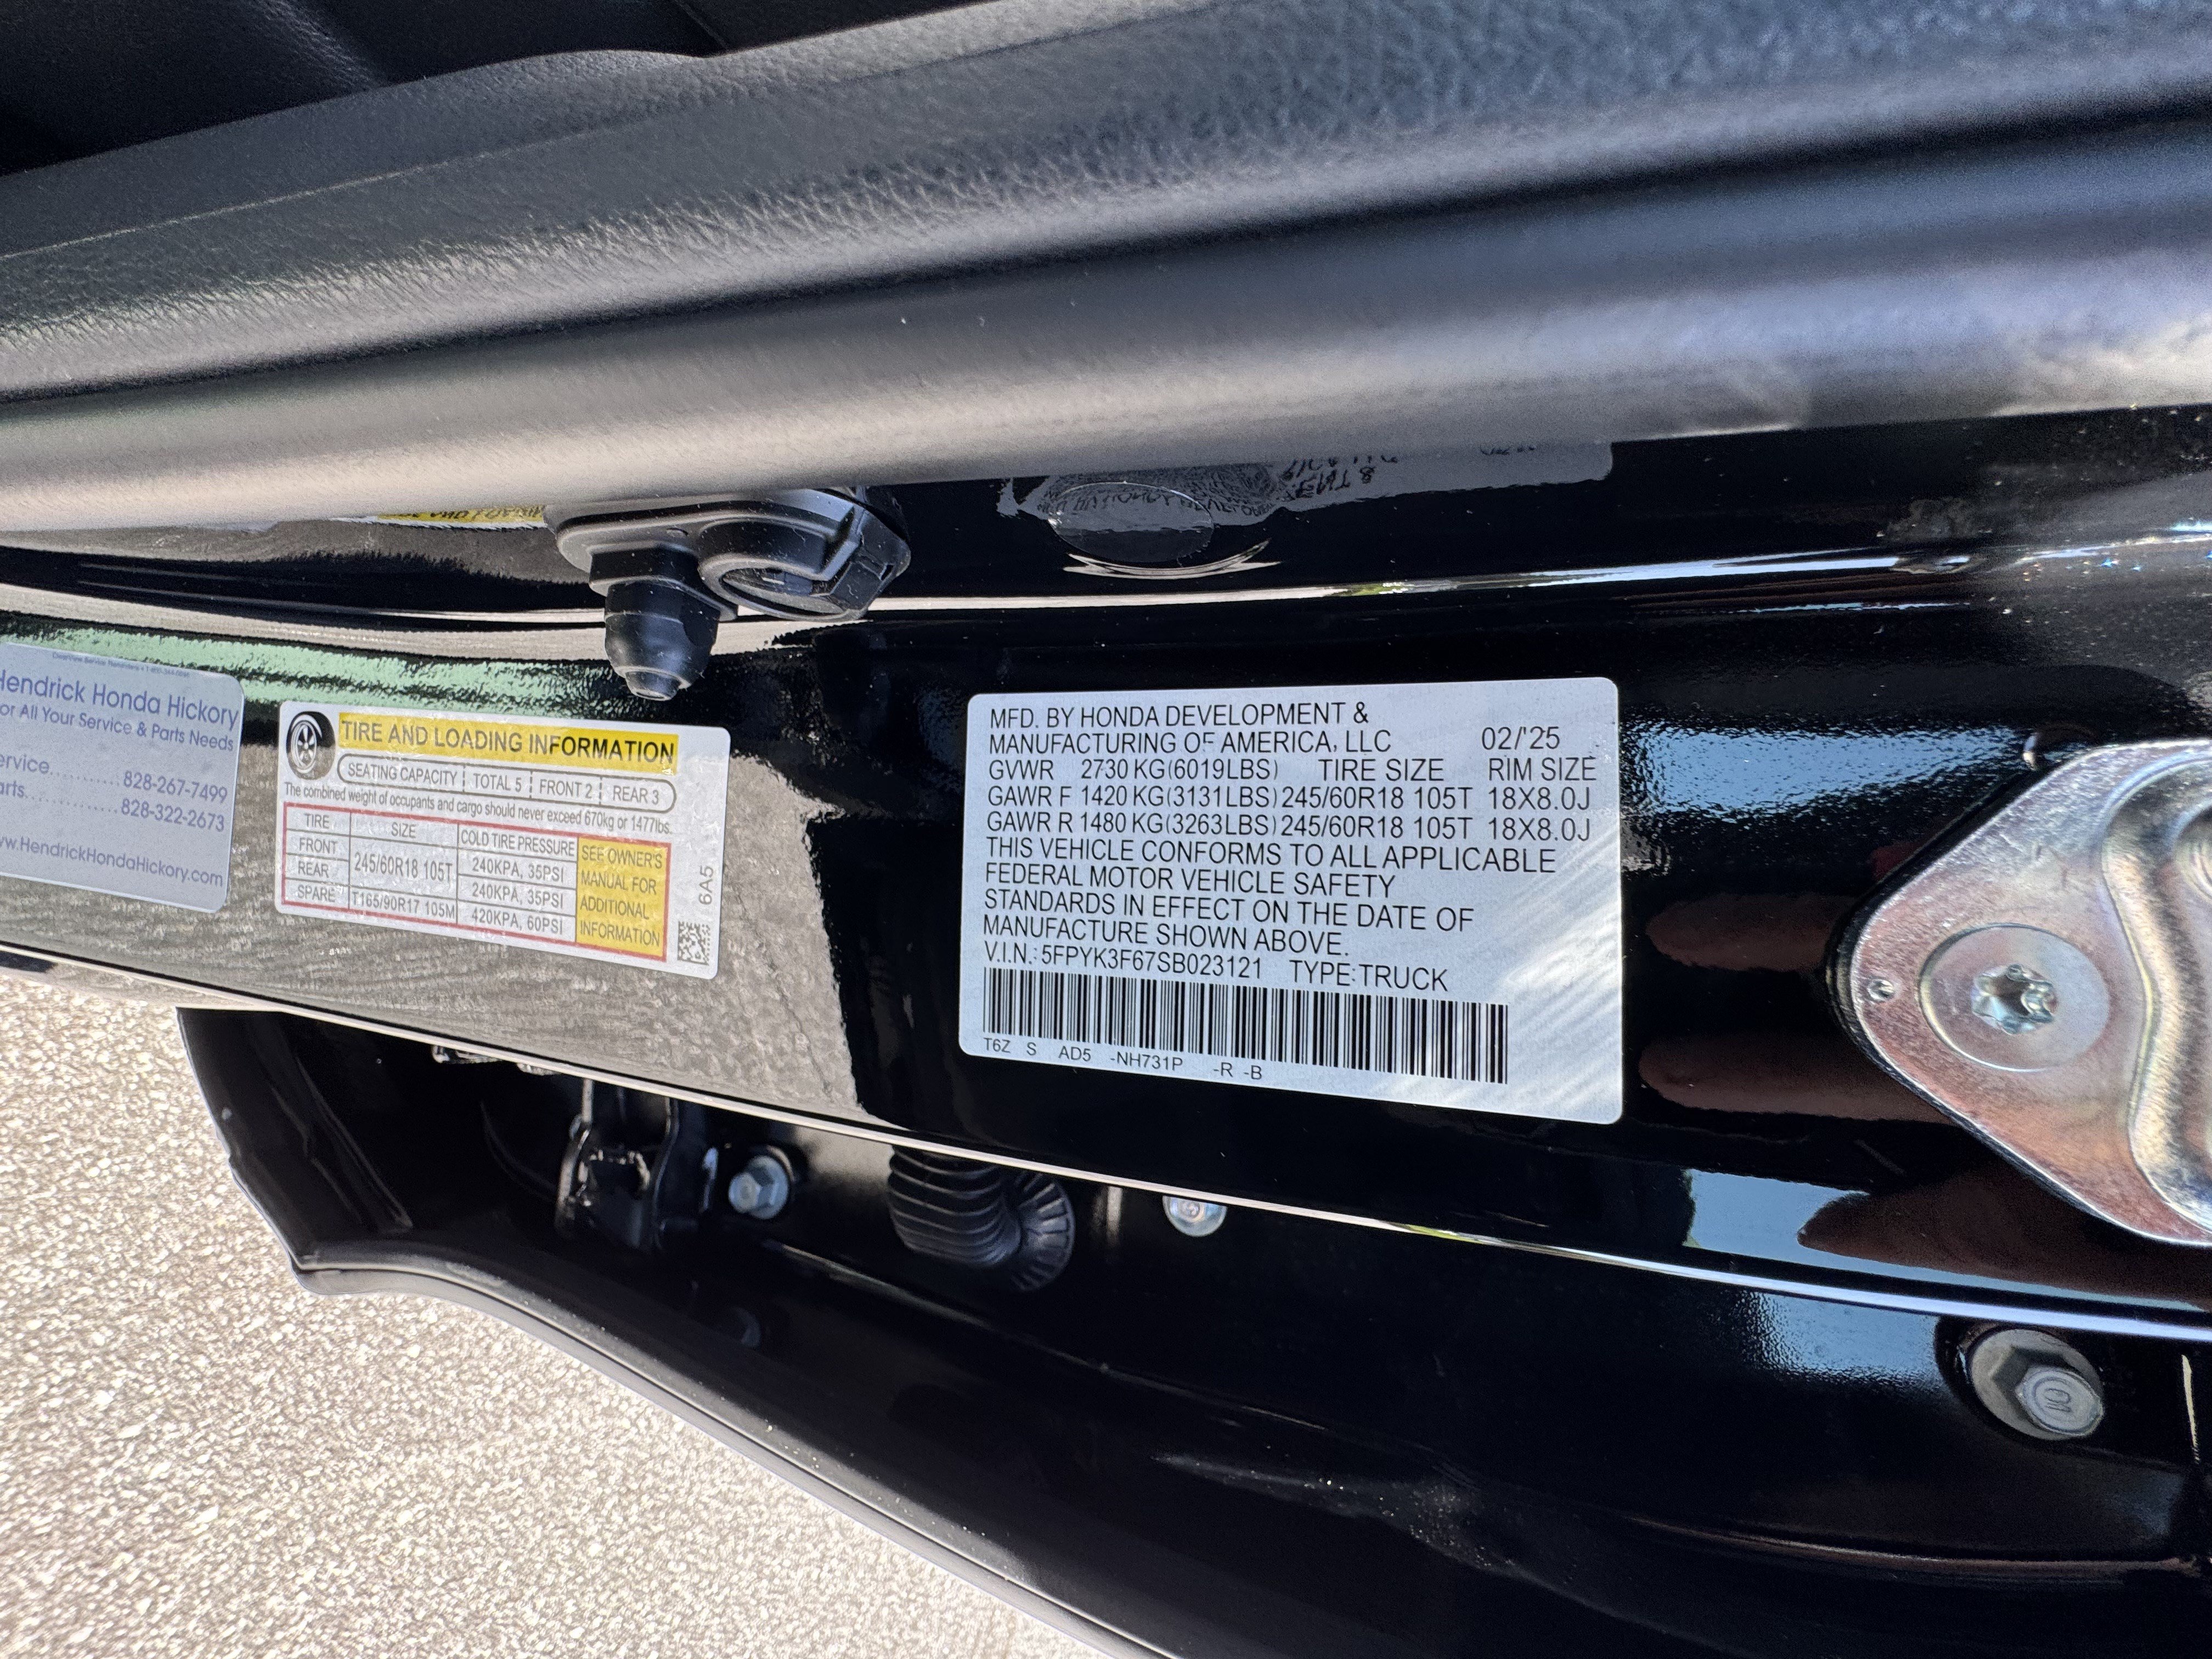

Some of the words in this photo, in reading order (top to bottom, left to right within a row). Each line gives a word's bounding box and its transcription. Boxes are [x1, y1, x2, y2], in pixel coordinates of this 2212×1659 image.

[93, 684, 160, 713] Honda
[168, 695, 239, 731] Hickory
[990, 708, 1039, 729] MFD.
[1047, 707, 1075, 727] BY
[1081, 706, 1159, 727] HONDA
[1166, 702, 1346, 726] DEVELOPMENT
[1353, 702, 1368, 724] &
[0, 704, 15, 716] or
[19, 704, 38, 720] All
[42, 706, 75, 726] Your
[79, 714, 132, 735] Service
[137, 724, 146, 737] &
[151, 725, 185, 743] Parts
[190, 731, 234, 752] Needs
[342, 721, 382, 742] TIRE
[388, 724, 428, 745] AND
[435, 726, 522, 752] LOADING
[529, 734, 674, 764] INFORMATION
[990, 732, 1176, 754] MANUFACTURING
[1184, 732, 1215, 753] OF
[1221, 730, 1337, 753] AMERICA,
[1346, 730, 1391, 753] LLC
[123, 770, 228, 804] 828-267-7499
[348, 763, 397, 780] SEATING
[400, 765, 458, 786] CAPACITY
[473, 773, 510, 791] TOTAL
[515, 777, 522, 792] 5
[540, 780, 582, 799] FRONT
[585, 784, 592, 799] 2
[613, 785, 648, 803] REAR
[652, 788, 659, 805] 3
[989, 759, 1054, 780] GVWR
[1081, 759, 1128, 780] 2730
[1318, 759, 1376, 781] TIRE
[1386, 758, 1444, 782] SIZE
[1489, 758, 1532, 781] RIM
[1541, 757, 1597, 781] SIZE
[121, 798, 224, 832] 828-322-2673
[285, 781, 301, 797] The
[304, 783, 346, 801] combined
[348, 788, 376, 806] weight
[379, 792, 388, 804] of
[390, 794, 435, 810] occupants
[438, 798, 454, 812] and
[457, 802, 482, 817] cargo
[486, 801, 515, 819] should
[518, 806, 545, 821] never
[546, 809, 582, 824] exceed
[585, 811, 614, 830] 670kg
[617, 817, 628, 830] or
[988, 786, 1052, 806] GAWR
[1060, 786, 1071, 806] F
[1081, 785, 1127, 806] 1420
[1414, 786, 1473, 810] 105T
[1488, 786, 1590, 810] 18X8.0J
[304, 813, 329, 828] TIRE
[391, 822, 416, 838] SIZE
[461, 830, 489, 847] COLD
[492, 832, 515, 850] TIRE
[518, 837, 575, 857] PRESSURE
[987, 811, 1051, 832] GAWR
[1058, 812, 1073, 833] R
[1080, 812, 1127, 833] 1480
[1414, 816, 1473, 840] 105T
[1488, 817, 1590, 842] 18X8.0J
[299, 837, 337, 854] FRONT
[355, 852, 418, 878] 245/60R18
[424, 862, 453, 882] 105T
[528, 864, 563, 882] 35PSI
[582, 845, 603, 862] SEE
[607, 848, 662, 869] OWNER'S
[986, 836, 1033, 859] THIS
[1040, 838, 1135, 861] VEHICLE
[1142, 840, 1282, 866] CONFORMS
[1289, 843, 1324, 867] TO
[1330, 844, 1377, 868] ALL
[1382, 845, 1556, 873] APPLICABLE
[298, 860, 329, 877] REAR
[528, 890, 563, 909] 35PSI
[582, 871, 628, 891] MANUAL
[632, 878, 657, 895] FOR
[698, 865, 714, 905] 6A5
[986, 862, 1084, 887] FEDERAL
[1090, 865, 1173, 890] MOTOR
[1181, 868, 1285, 894] VEHICLE
[1294, 872, 1396, 898] SAFETY
[298, 884, 335, 902] SPARE
[425, 899, 455, 919] 105M
[527, 916, 563, 935] 60PSI
[580, 896, 649, 919] ADDITIONAL
[984, 888, 1116, 915] STANDARDS
[1124, 894, 1144, 916] IN
[1153, 895, 1245, 921] EFFECT
[1252, 900, 1289, 923] ON
[1297, 901, 1348, 927] THE
[1358, 904, 1426, 930] DATE
[1436, 907, 1474, 932] OF
[580, 921, 659, 947] INFORMATION
[983, 915, 1149, 944] MANUFACTURE
[1156, 923, 1247, 950] SHOWN
[1254, 928, 1350, 957] ABOVE.
[984, 1037, 1011, 1053] T6Z
[1026, 1042, 1037, 1056] S
[1058, 1046, 1091, 1062] AD5
